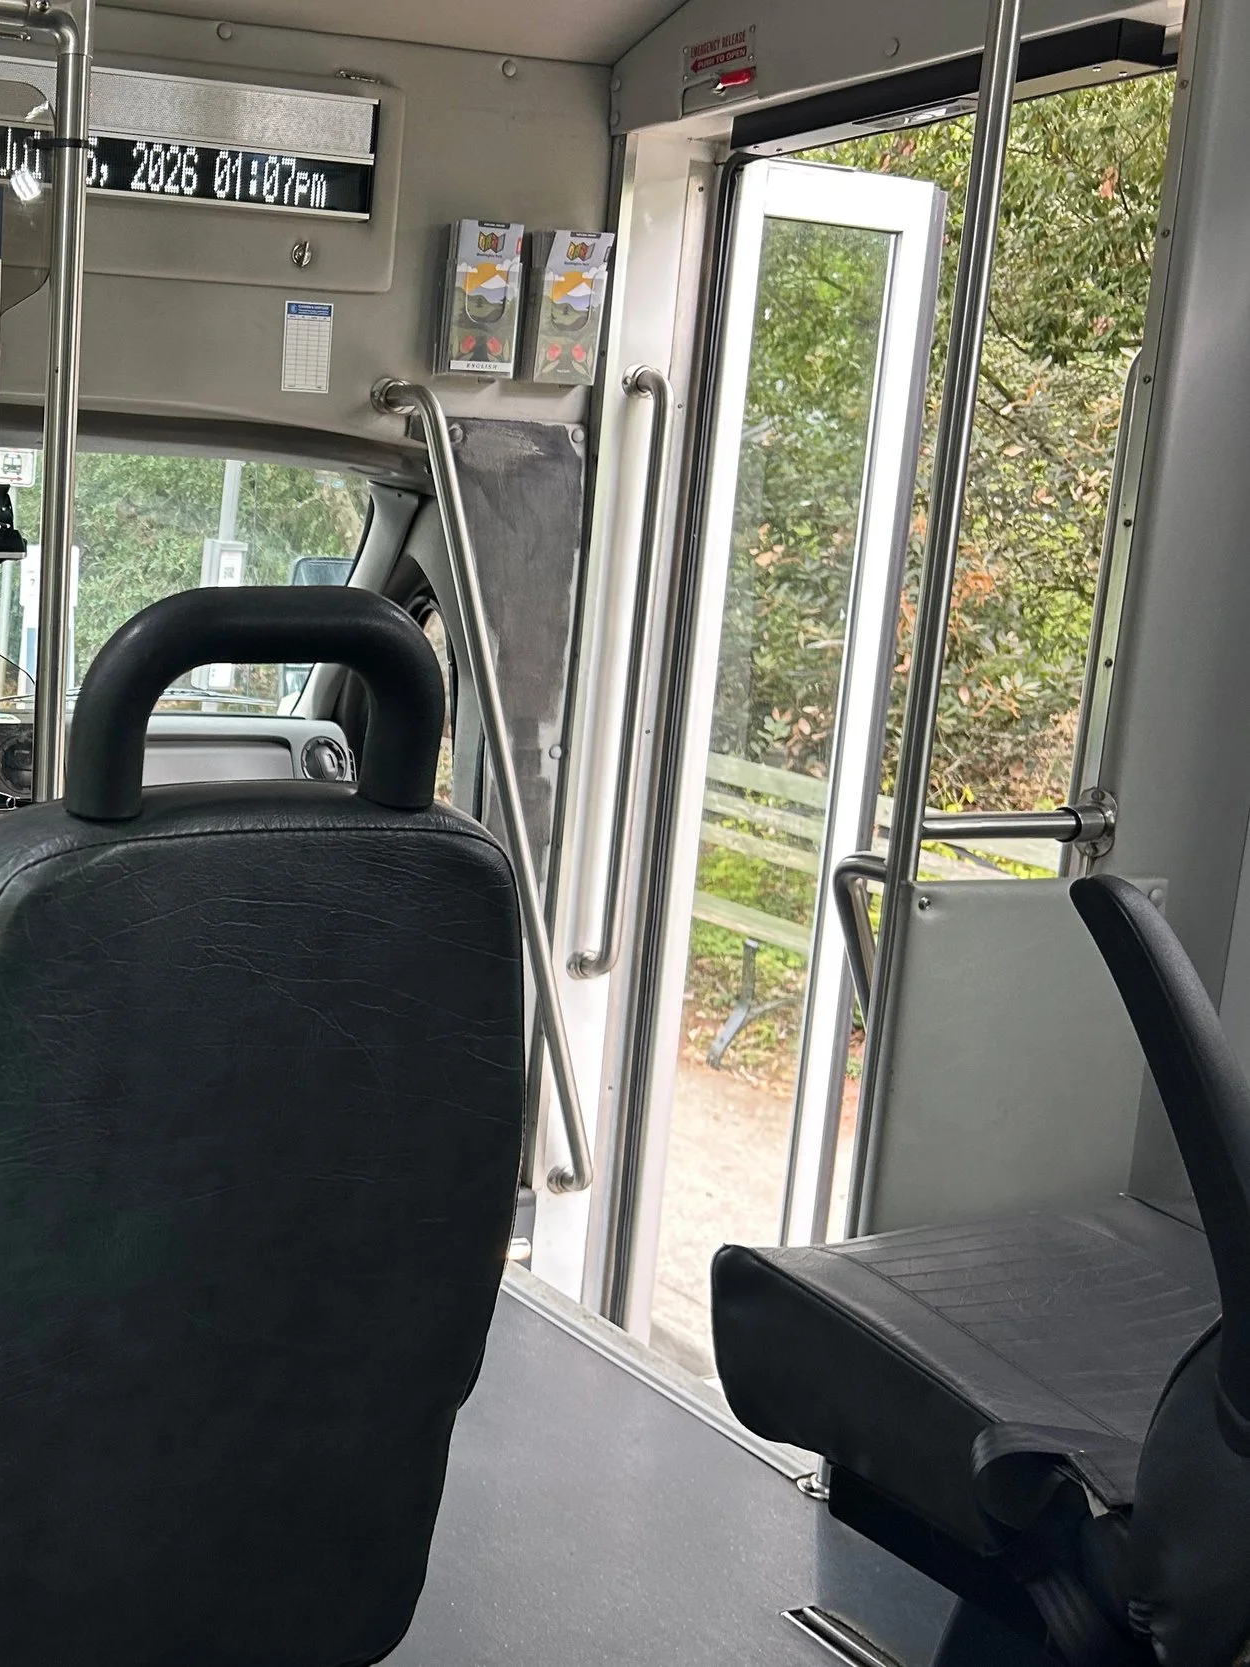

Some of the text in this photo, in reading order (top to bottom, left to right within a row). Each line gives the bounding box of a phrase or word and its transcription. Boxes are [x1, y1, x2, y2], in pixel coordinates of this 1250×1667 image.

[691, 30, 745, 58] EMERGENCY RELEASE
[698, 48, 745, 68] PUSH TO OPEN
[131, 141, 198, 195] 2026
